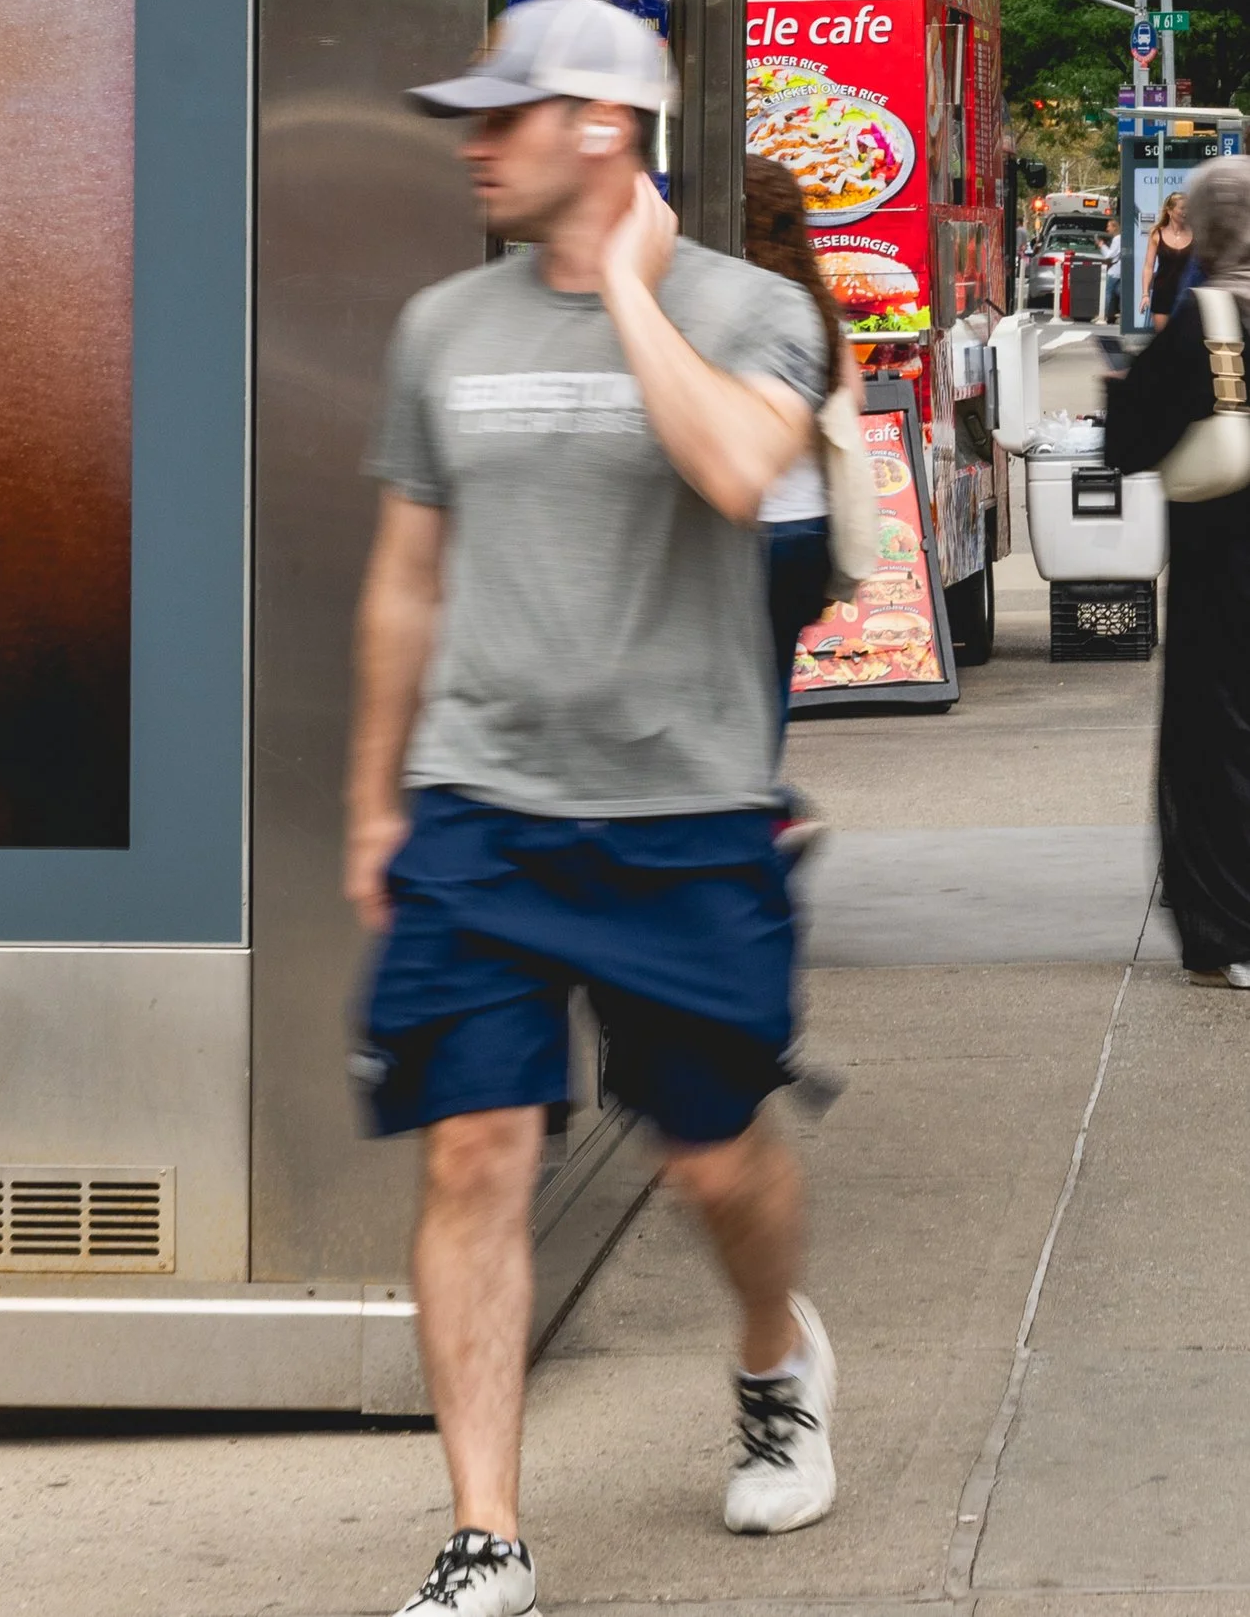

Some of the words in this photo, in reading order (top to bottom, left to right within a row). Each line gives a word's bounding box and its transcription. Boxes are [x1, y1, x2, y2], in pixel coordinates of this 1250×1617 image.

[746, 7, 799, 46] cle
[808, 4, 893, 46] cafe
[1153, 16, 1160, 28] W
[1164, 15, 1173, 29] 61
[746, 57, 761, 70] MB
[762, 55, 798, 67] OVER
[799, 57, 829, 75] RICE
[761, 84, 818, 107] CHICKEN
[820, 83, 857, 97] OVER
[858, 87, 890, 107] RICE
[1223, 137, 1234, 157] Bro
[865, 423, 901, 442] cafe
